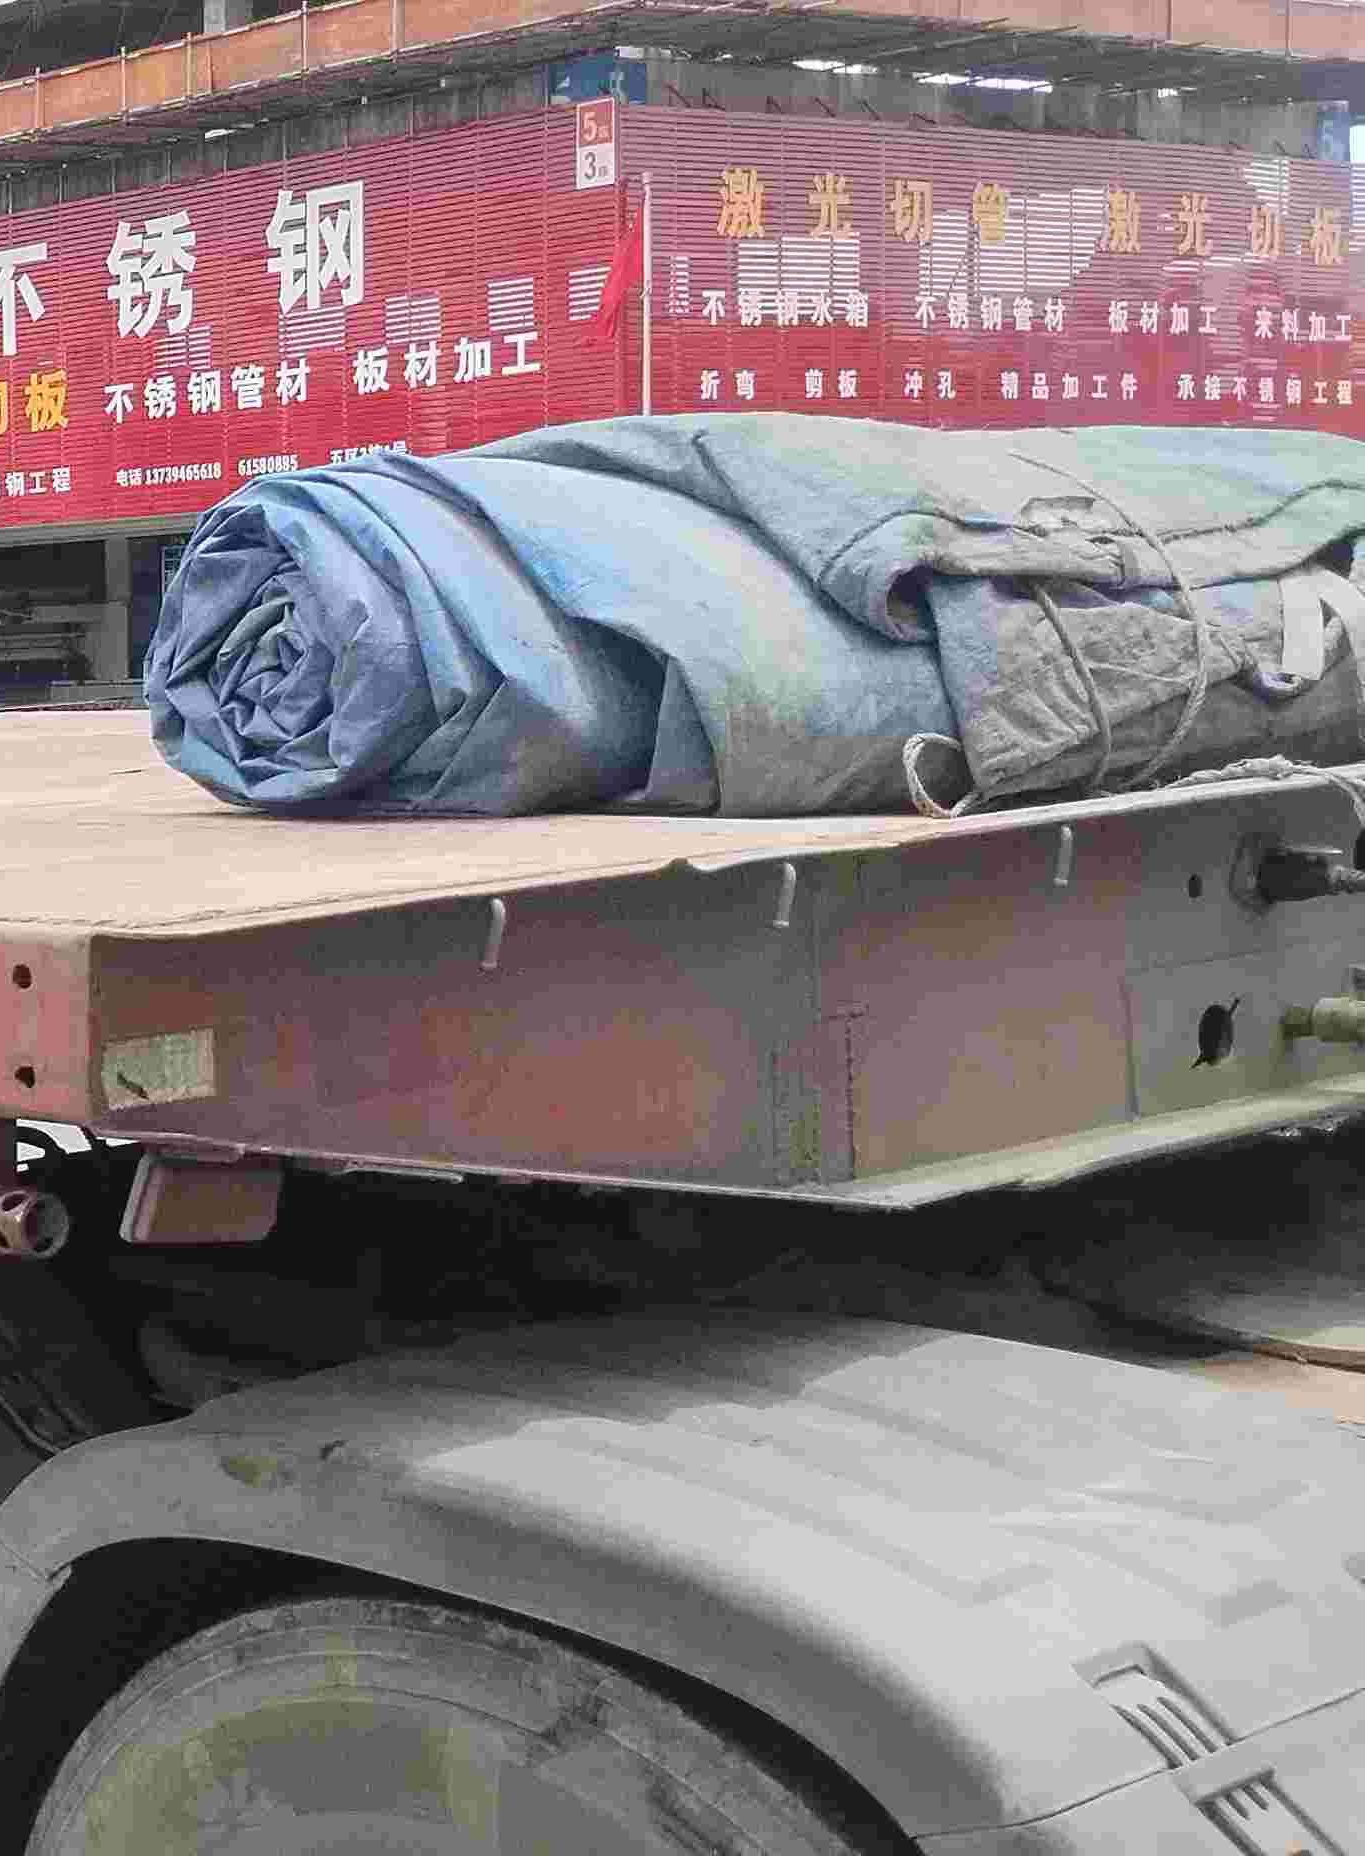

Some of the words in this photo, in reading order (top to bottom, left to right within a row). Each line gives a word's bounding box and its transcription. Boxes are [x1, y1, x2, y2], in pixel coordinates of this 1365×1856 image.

[716, 167, 1008, 244] 激光切管
[1103, 190, 1345, 266] 激光切板
[702, 289, 869, 327] 不锈钢水箱
[915, 294, 1065, 332] 不锈钢管材
[1109, 300, 1219, 335] 板材加工
[1254, 306, 1352, 343] 来料加工
[104, 357, 310, 423] 不锈钢管材
[352, 332, 540, 395] 板材加工
[700, 369, 756, 400] 折弯
[805, 369, 858, 400] 剪板
[904, 371, 957, 401] 冲孔
[1000, 370, 1138, 401] 精品加工件
[1177, 374, 1352, 406] 承接不锈钢工程
